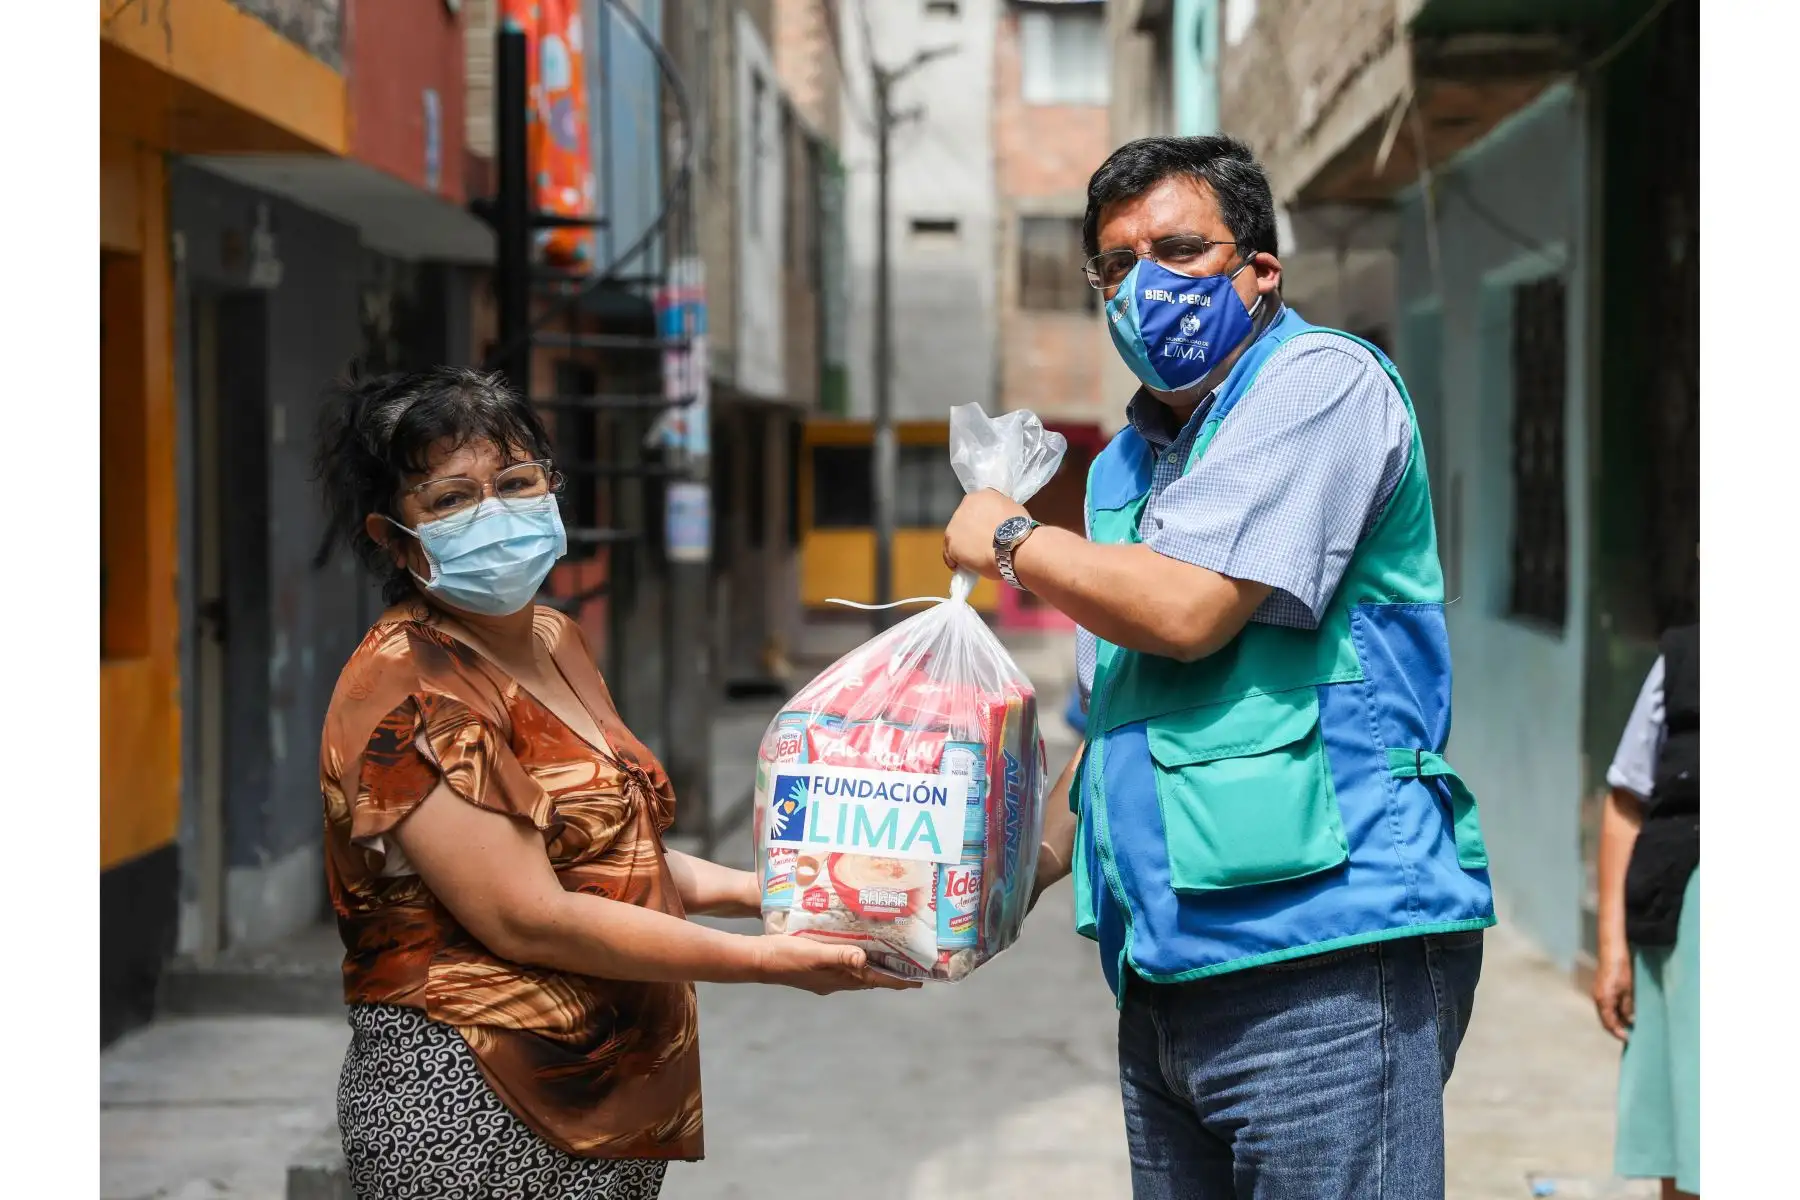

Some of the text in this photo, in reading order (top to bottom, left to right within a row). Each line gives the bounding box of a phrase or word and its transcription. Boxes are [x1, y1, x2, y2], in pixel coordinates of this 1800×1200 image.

[1144, 289, 1211, 307] BIEN, PERÚ!
[1164, 344, 1205, 363] LIMA
[813, 775, 948, 806] FUNDACIÓN
[808, 800, 942, 855] LIMA
[1002, 746, 1021, 897] ALIANZA
